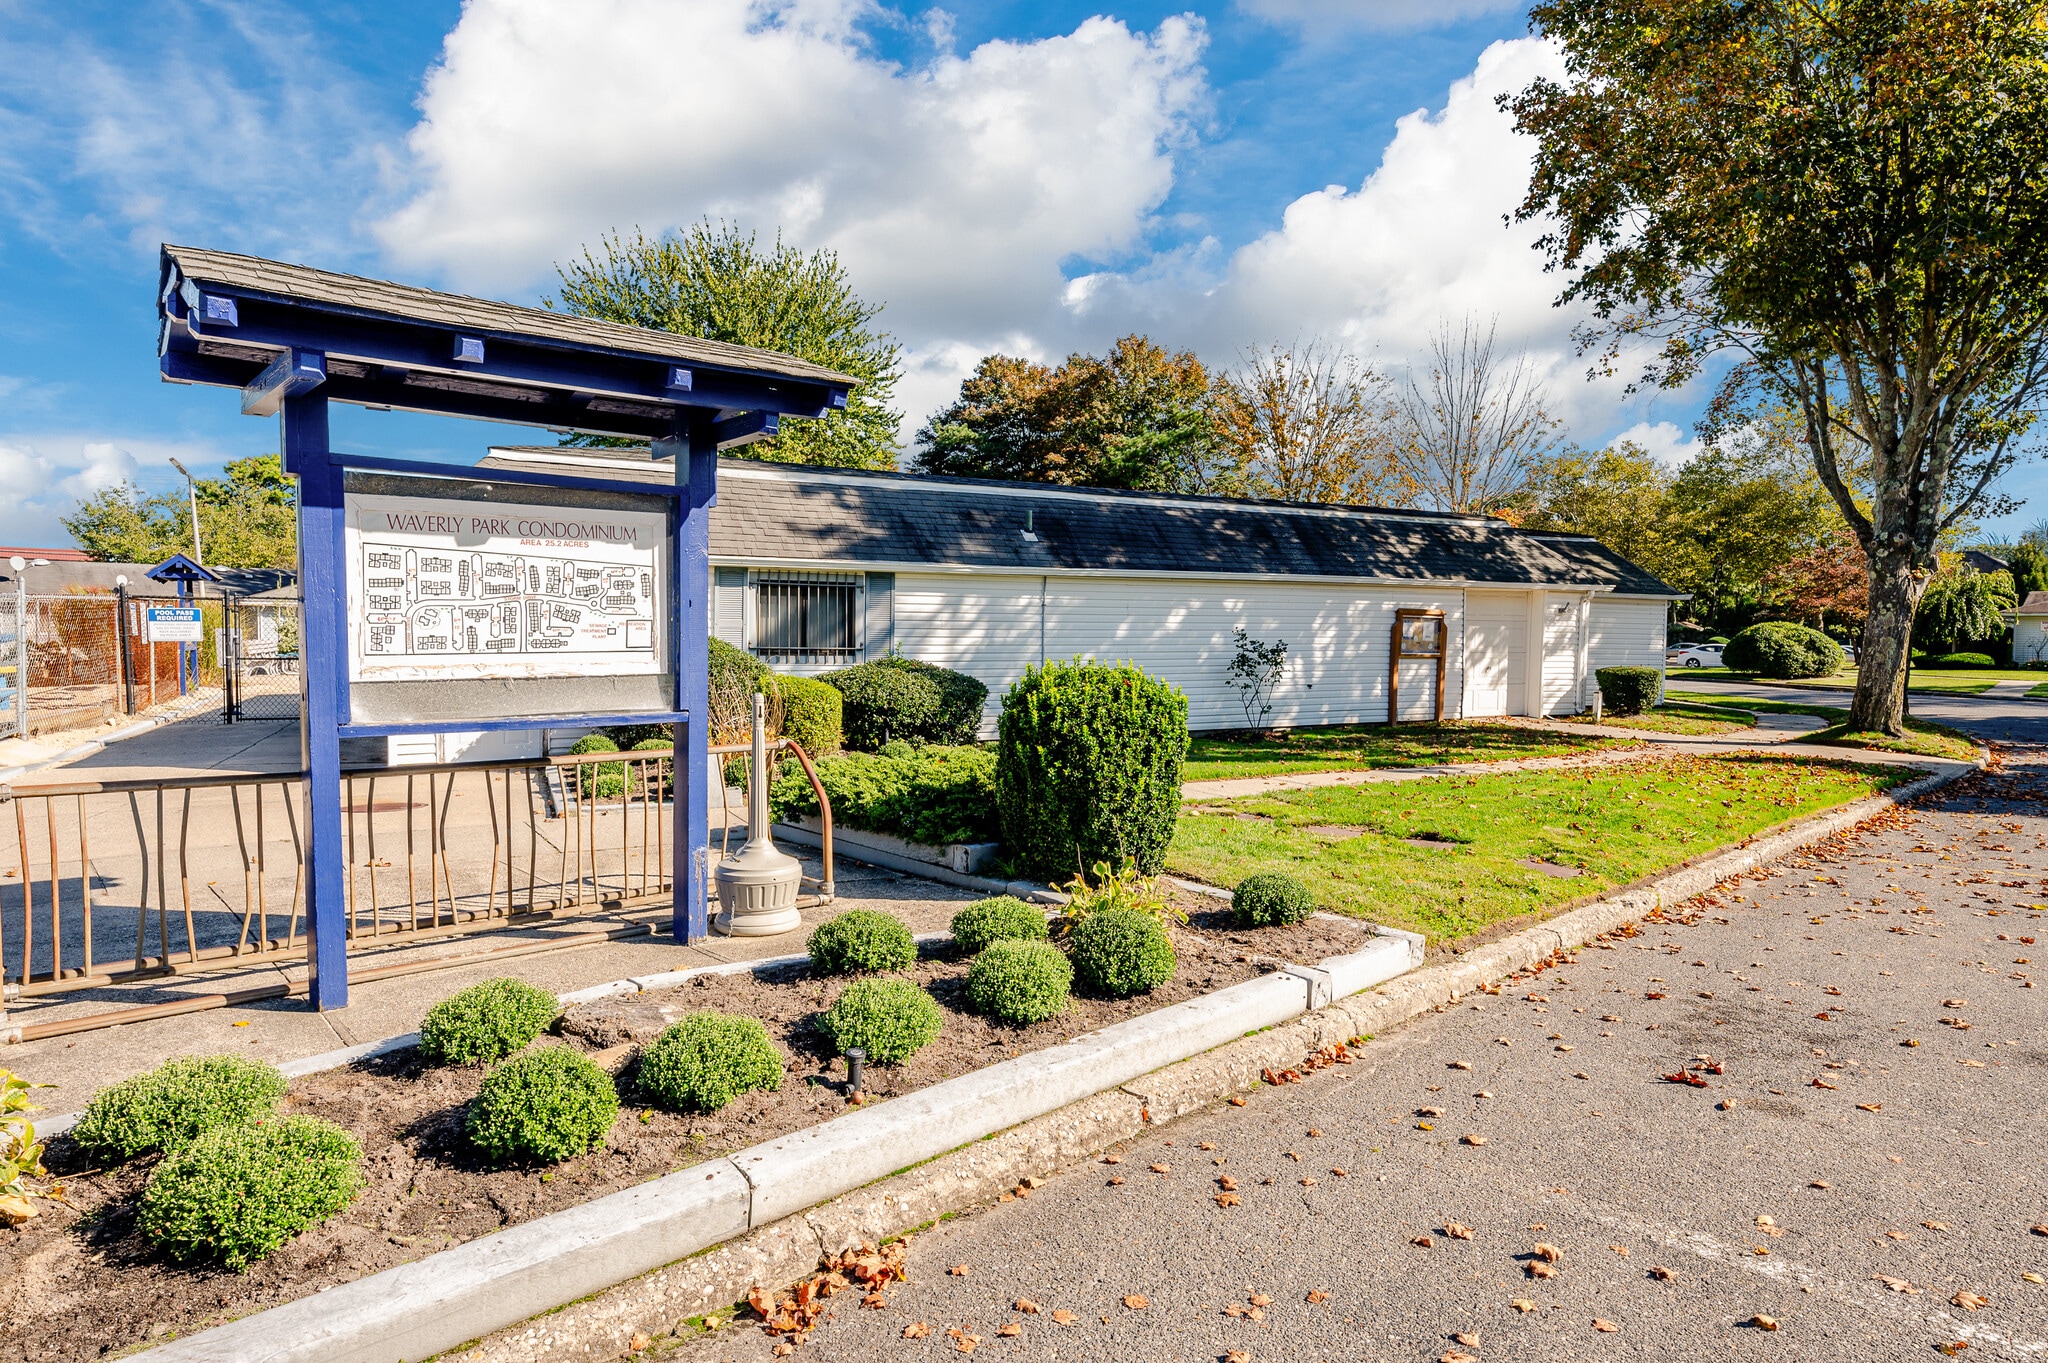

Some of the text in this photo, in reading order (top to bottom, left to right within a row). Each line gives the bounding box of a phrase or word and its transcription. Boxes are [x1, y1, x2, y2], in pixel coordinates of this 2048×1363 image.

[386, 513, 637, 541] WAVERLY PARK CONDOMINIUM
[520, 538, 542, 546] AREA
[563, 540, 590, 548] ACRES
